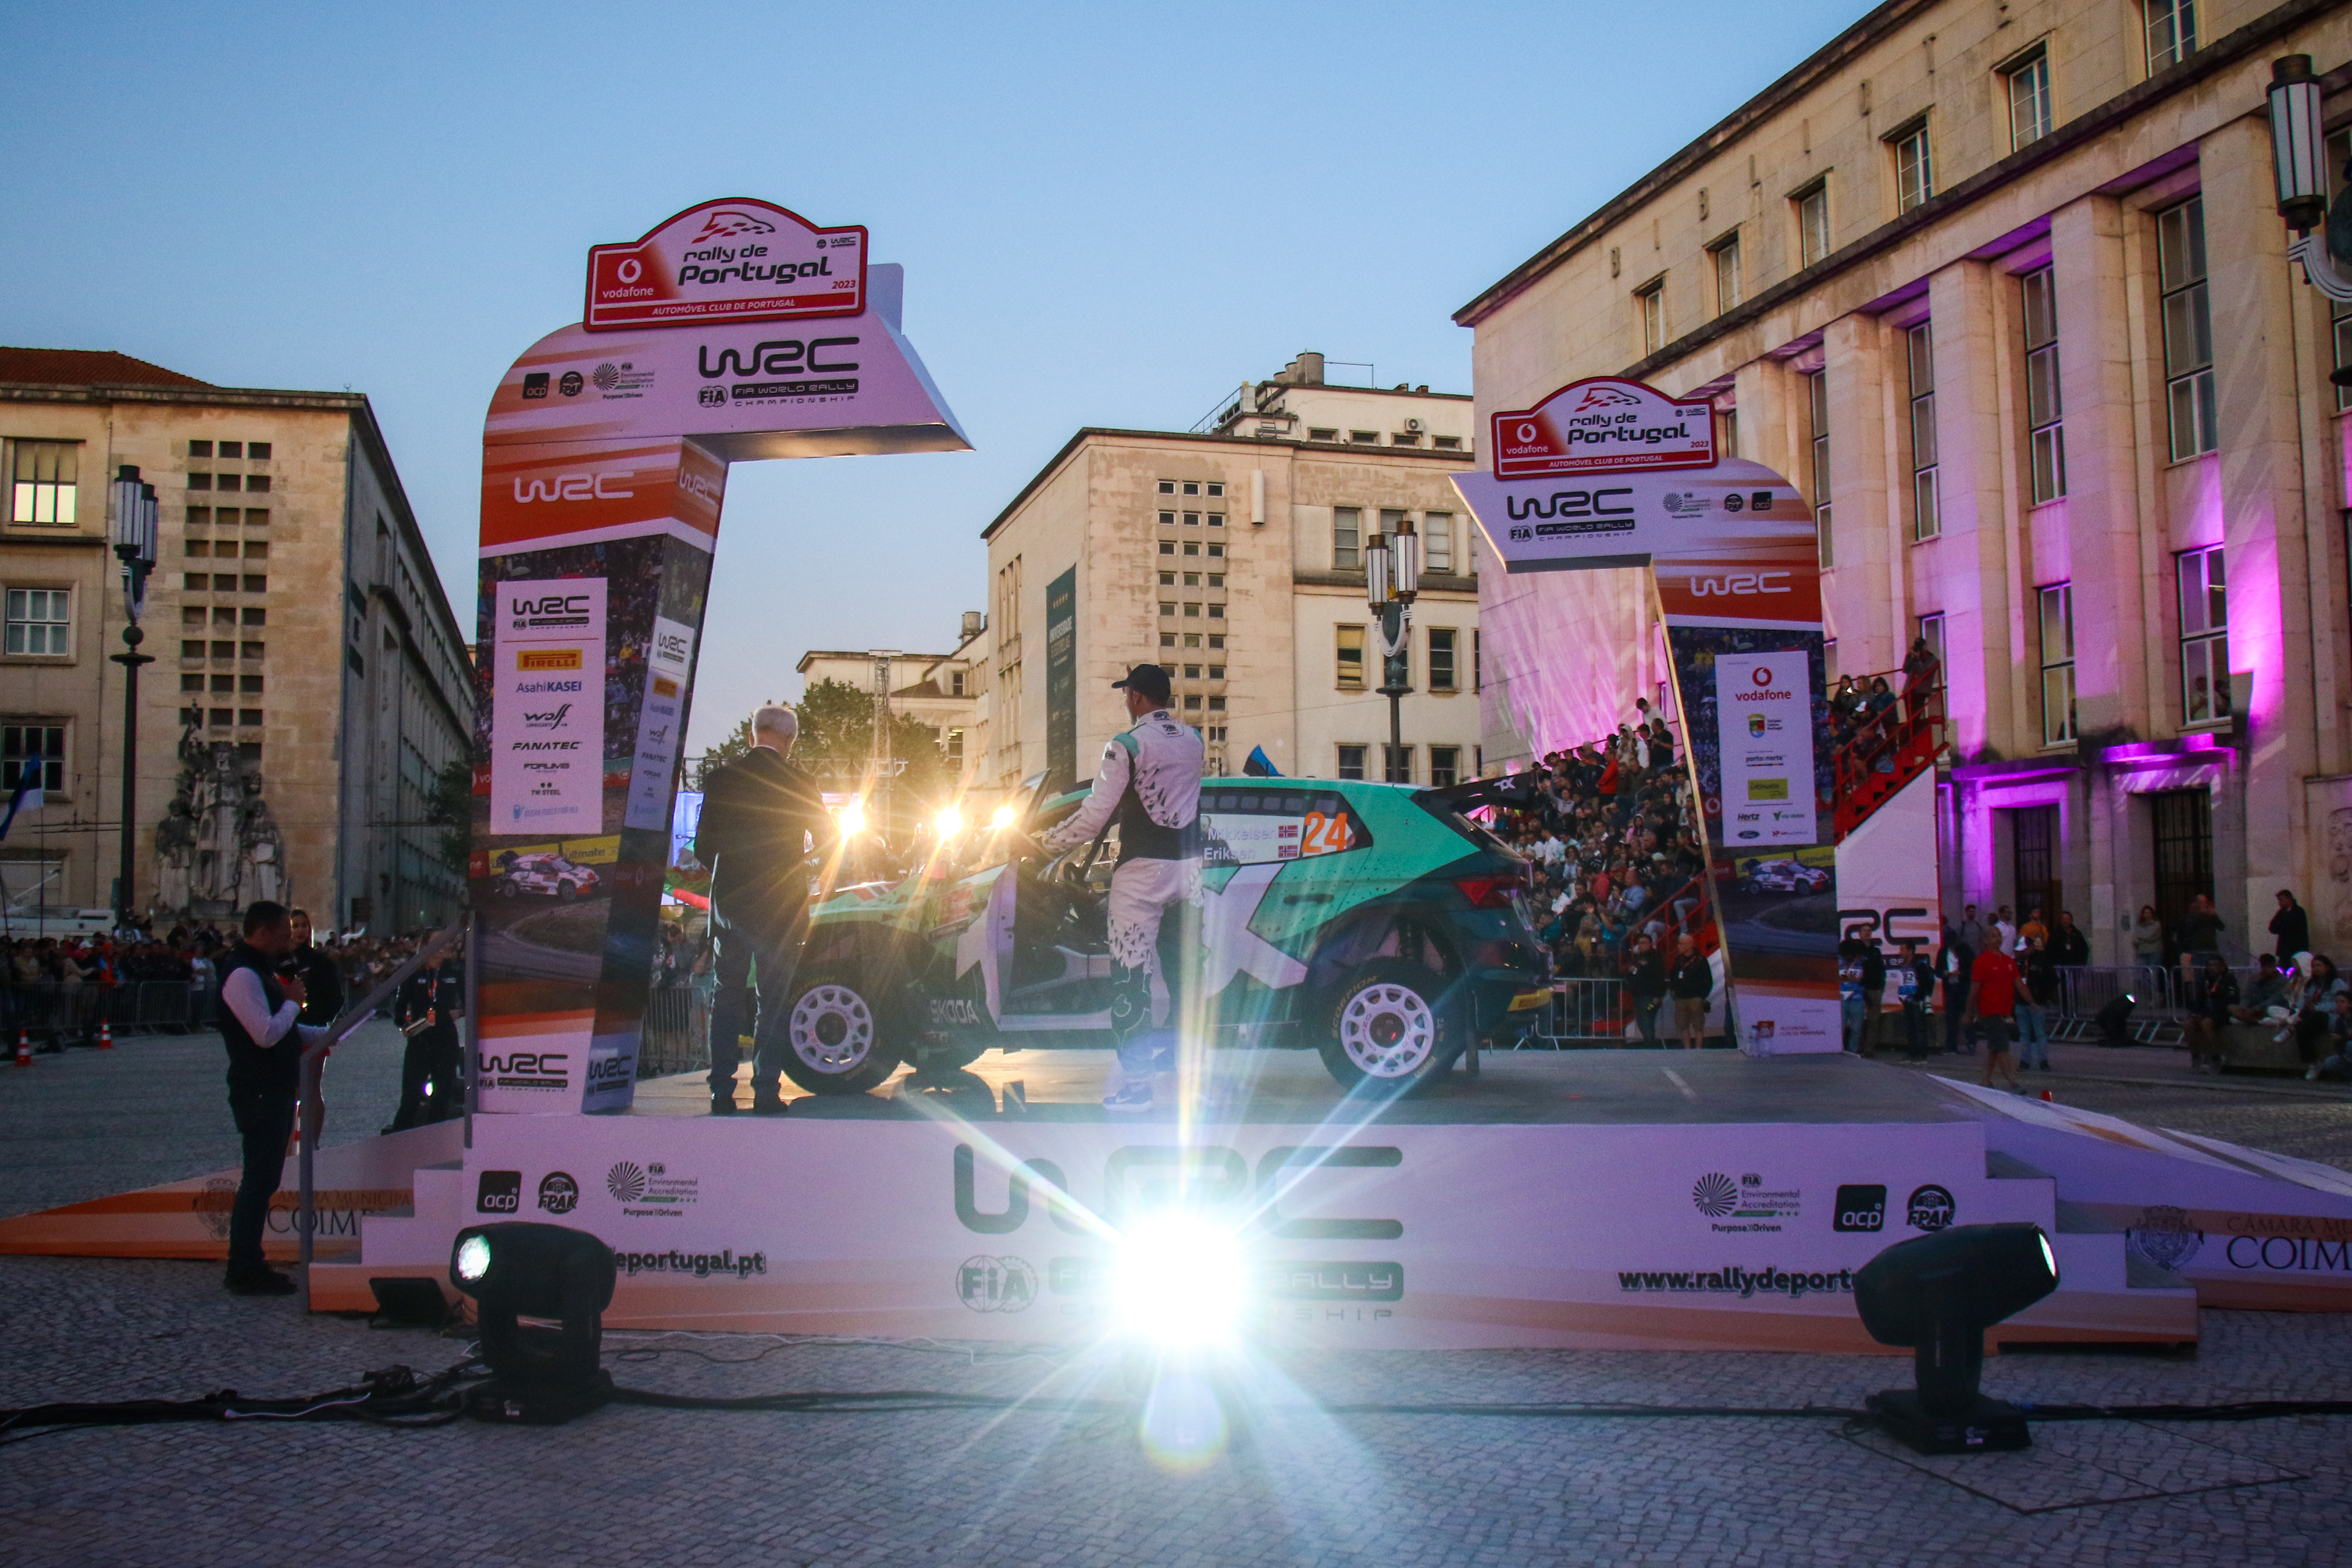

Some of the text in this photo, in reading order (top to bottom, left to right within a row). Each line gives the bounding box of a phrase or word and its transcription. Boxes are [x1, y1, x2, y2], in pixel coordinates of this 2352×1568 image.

[684, 244, 767, 263] rally de
[678, 256, 832, 286] Portugal
[603, 287, 654, 298] vodafone
[832, 280, 856, 290] 2023
[652, 300, 795, 315] AUTOMÓVEL CLUB DE PORTUGAL
[699, 337, 860, 379] WRC
[527, 387, 547, 397] acp
[736, 396, 854, 407] CHAMPIONSHIP
[1569, 413, 1637, 428] rally de
[1567, 423, 1690, 445] Portugal
[1506, 445, 1548, 455] vodafone
[1548, 458, 1593, 467] AUTOMÓVEL
[514, 472, 634, 503] WRC
[679, 467, 721, 505] WRC
[1507, 488, 1634, 520] WRC
[1539, 532, 1632, 541] CHAMPIONSHIP
[1691, 572, 1791, 597] WRC
[513, 596, 589, 615] WRC
[658, 633, 687, 654] WRC
[523, 654, 576, 668] PIRELLI
[1735, 690, 1792, 701] vodafone
[513, 742, 580, 750] FANATEC
[1301, 811, 1348, 853] 24
[1204, 847, 1254, 860] Eriksen
[1838, 908, 1929, 946] RC
[479, 1052, 568, 1074] WRC
[589, 1055, 632, 1080] WRC
[649, 1178, 698, 1186] Environmental
[336, 1191, 412, 1207] MUNICIPA
[484, 1195, 516, 1210] acp
[538, 1195, 578, 1209] FPAK
[1741, 1189, 1800, 1199] Environmental
[267, 1205, 368, 1235] COIM
[1842, 1211, 1881, 1228] acp
[1907, 1210, 1954, 1226] FPAK
[2227, 1215, 2315, 1233] CÂMARA
[2227, 1235, 2352, 1271] COIM
[614, 1250, 764, 1277] eportugal.pt
[1618, 1267, 1855, 1295] www.rallydeport
